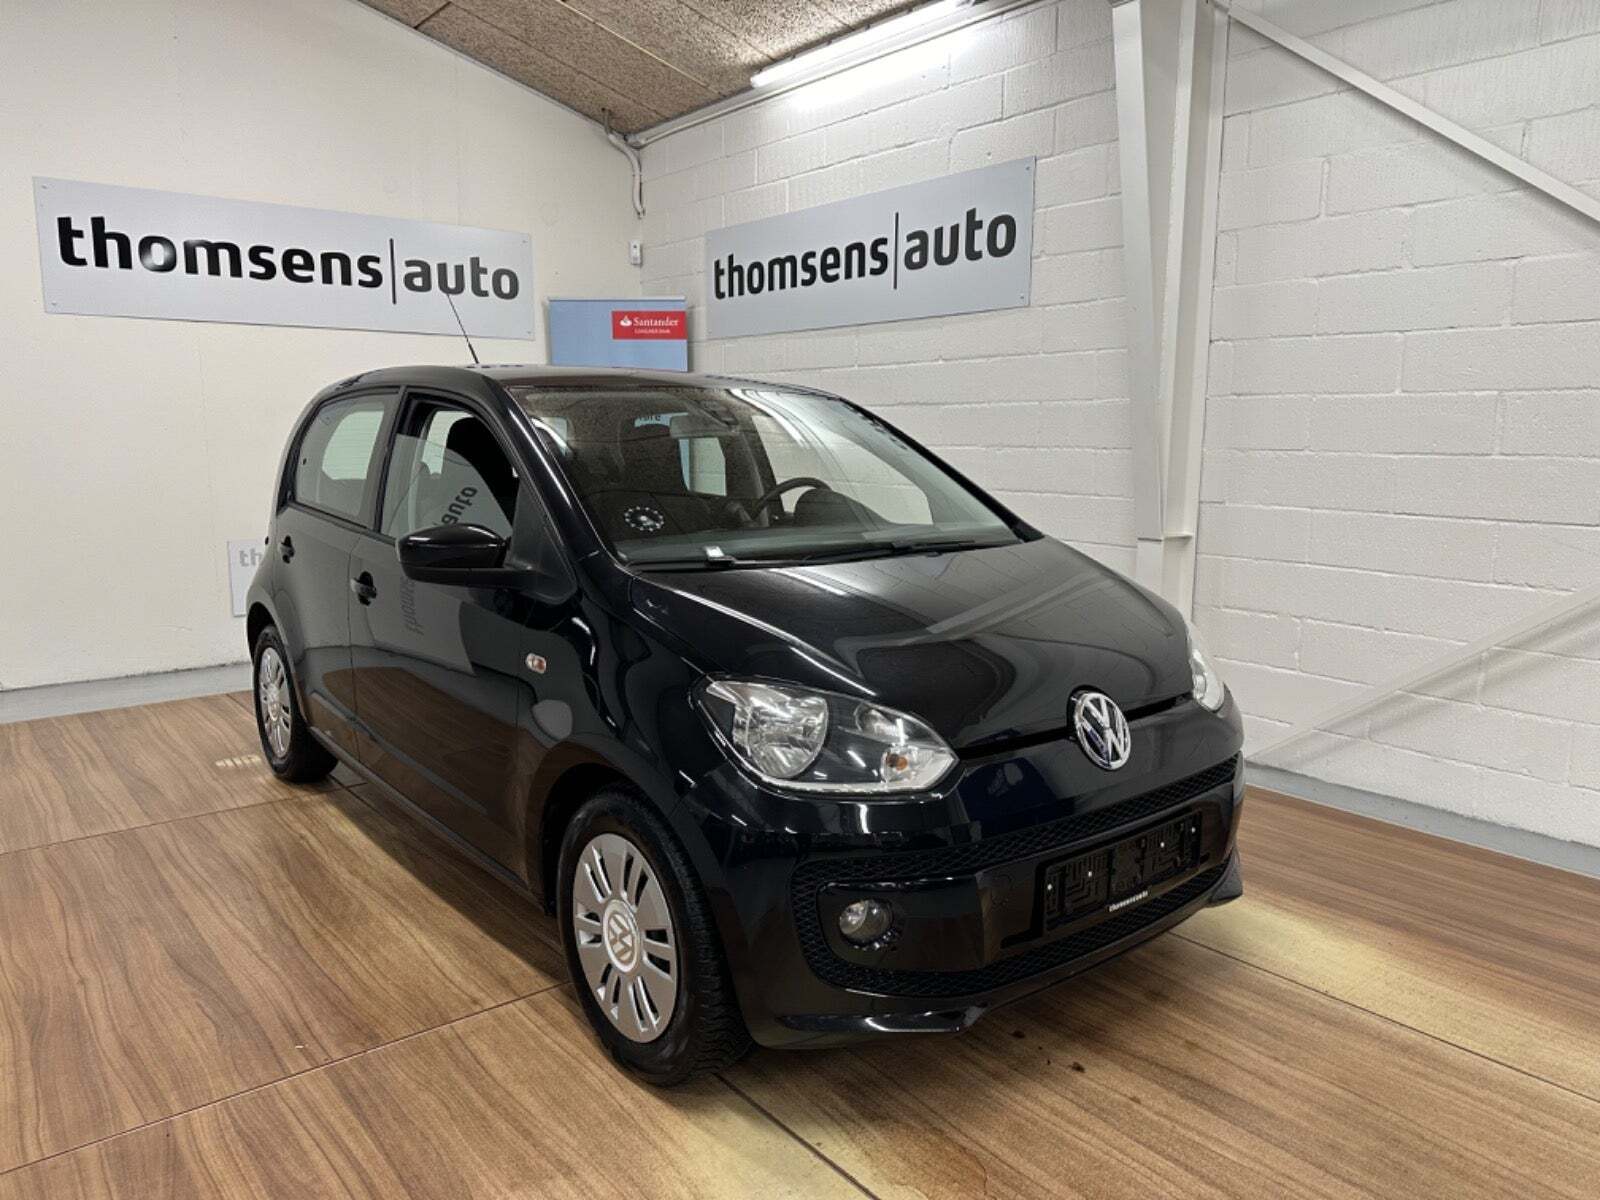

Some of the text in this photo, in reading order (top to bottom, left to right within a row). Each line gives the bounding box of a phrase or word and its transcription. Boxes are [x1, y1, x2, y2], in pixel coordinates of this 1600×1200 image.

[57, 216, 520, 300] thomsens auto
[714, 207, 1017, 300] thomsens auto
[633, 315, 679, 327] Santander
